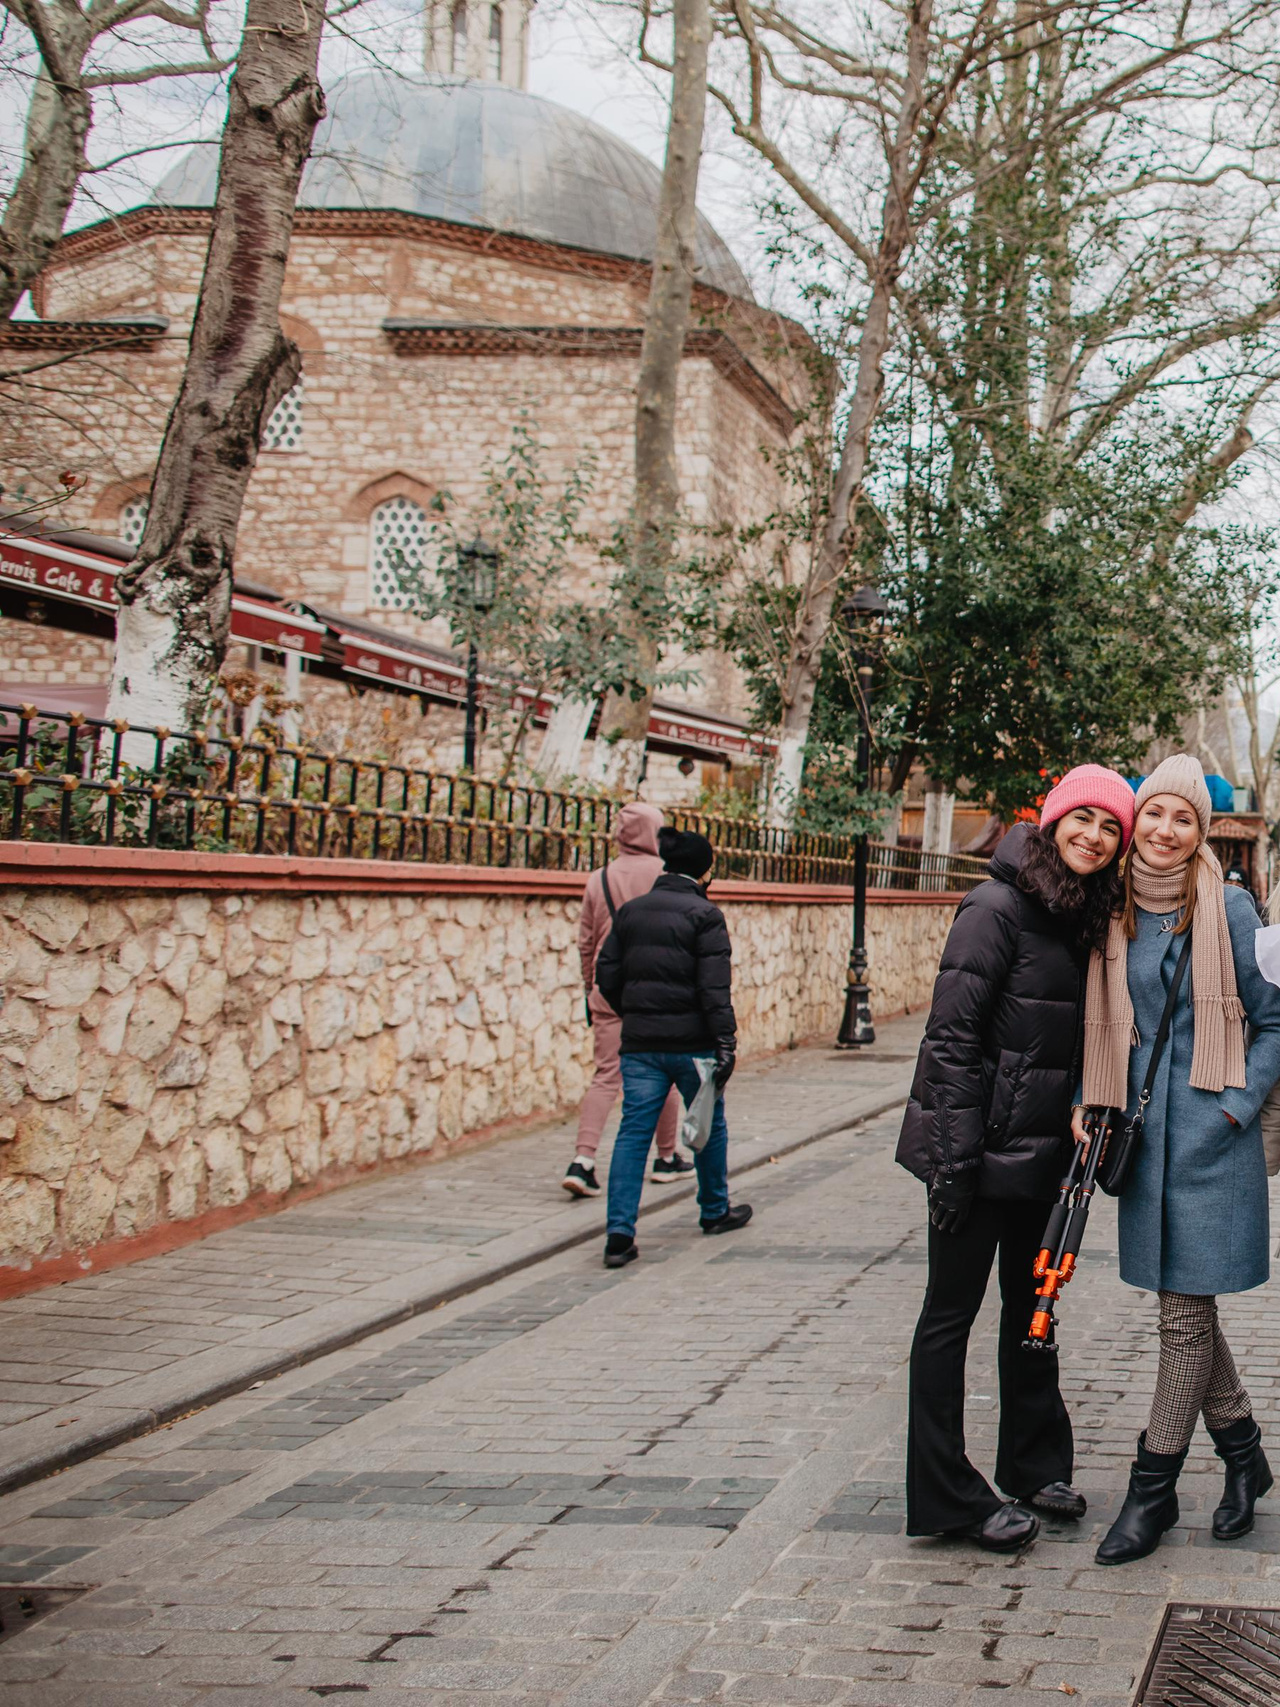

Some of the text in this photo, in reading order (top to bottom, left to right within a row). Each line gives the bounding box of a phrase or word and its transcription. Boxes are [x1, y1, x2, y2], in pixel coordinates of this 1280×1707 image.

[0, 556, 37, 584] erviş
[45, 567, 82, 592] Cafe
[88, 578, 103, 598] &
